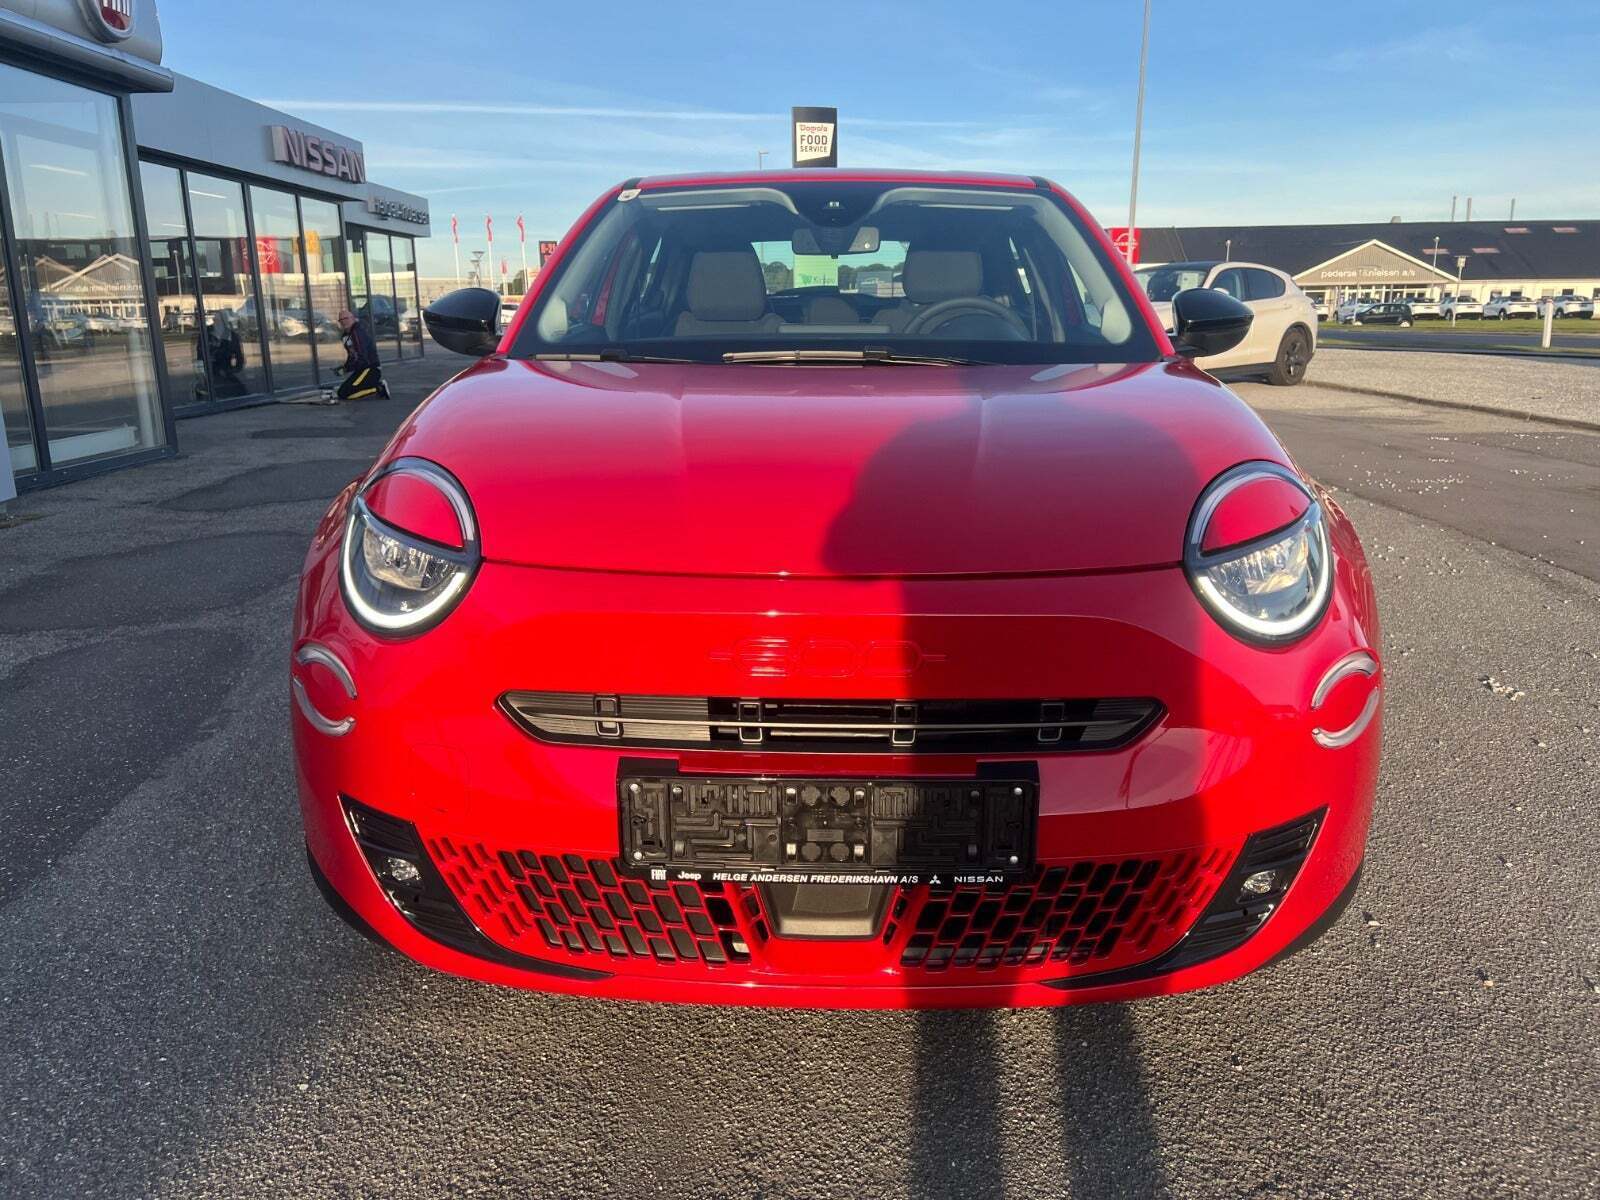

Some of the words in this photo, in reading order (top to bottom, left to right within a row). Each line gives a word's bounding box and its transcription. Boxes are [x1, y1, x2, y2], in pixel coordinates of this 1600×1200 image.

[800, 134, 828, 145] FOOD
[800, 145, 828, 153] SERVICE
[272, 126, 366, 184] NISSAN
[651, 869, 667, 881] FIAT
[678, 871, 702, 881] Jeep
[713, 872, 748, 882] HELGE
[750, 873, 808, 883] ANDERSEN
[810, 875, 899, 884] FREDERIKSHAVN
[900, 875, 919, 884] A/S
[954, 875, 1004, 883] NISSAN
